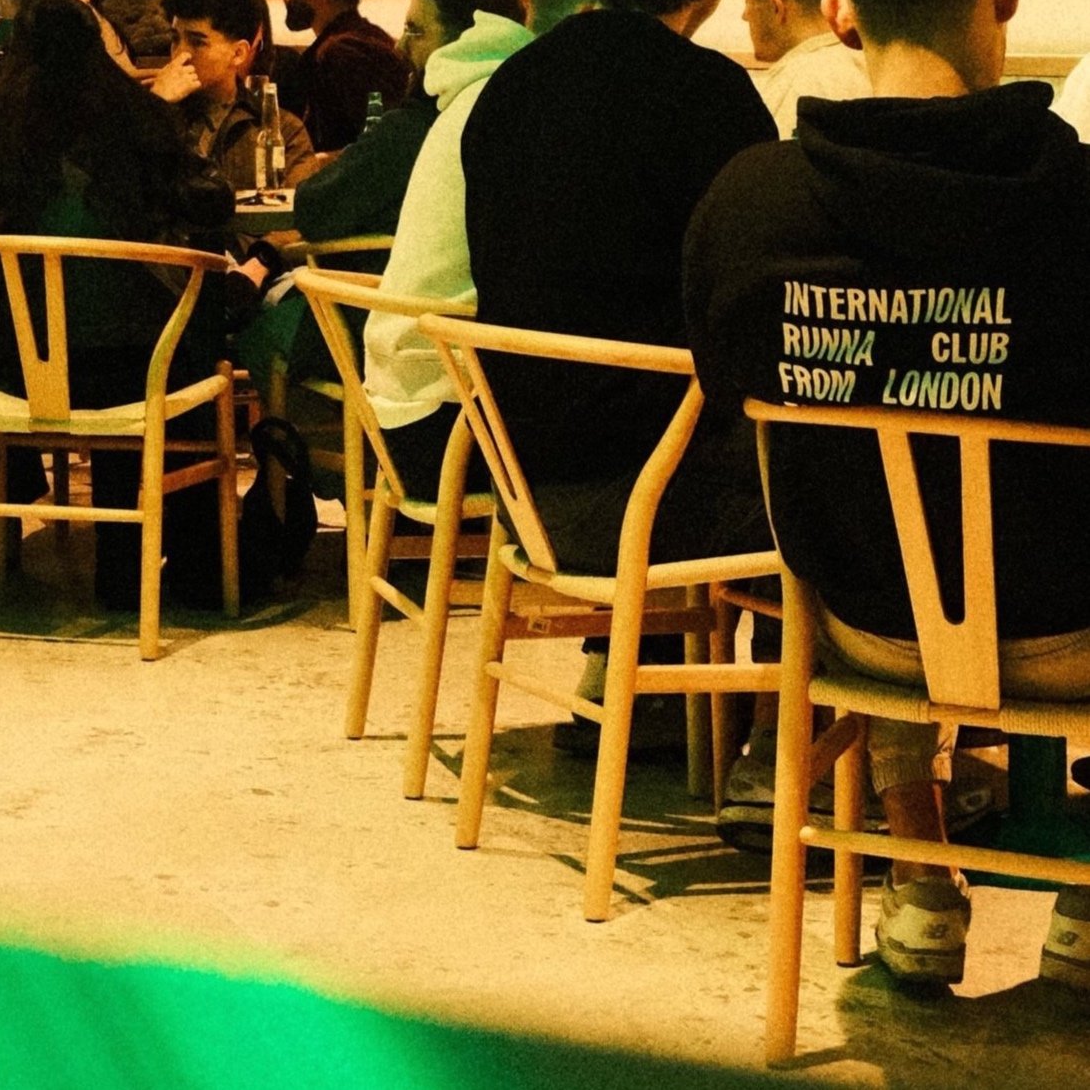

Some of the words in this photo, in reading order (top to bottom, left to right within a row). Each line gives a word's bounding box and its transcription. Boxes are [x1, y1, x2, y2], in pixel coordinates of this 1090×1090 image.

[783, 281, 1012, 324] INTERNATIONAL
[781, 322, 876, 366] RUNNA
[931, 332, 1010, 364] CLUB
[778, 361, 856, 403] FROM
[882, 368, 1003, 410] LONDON
